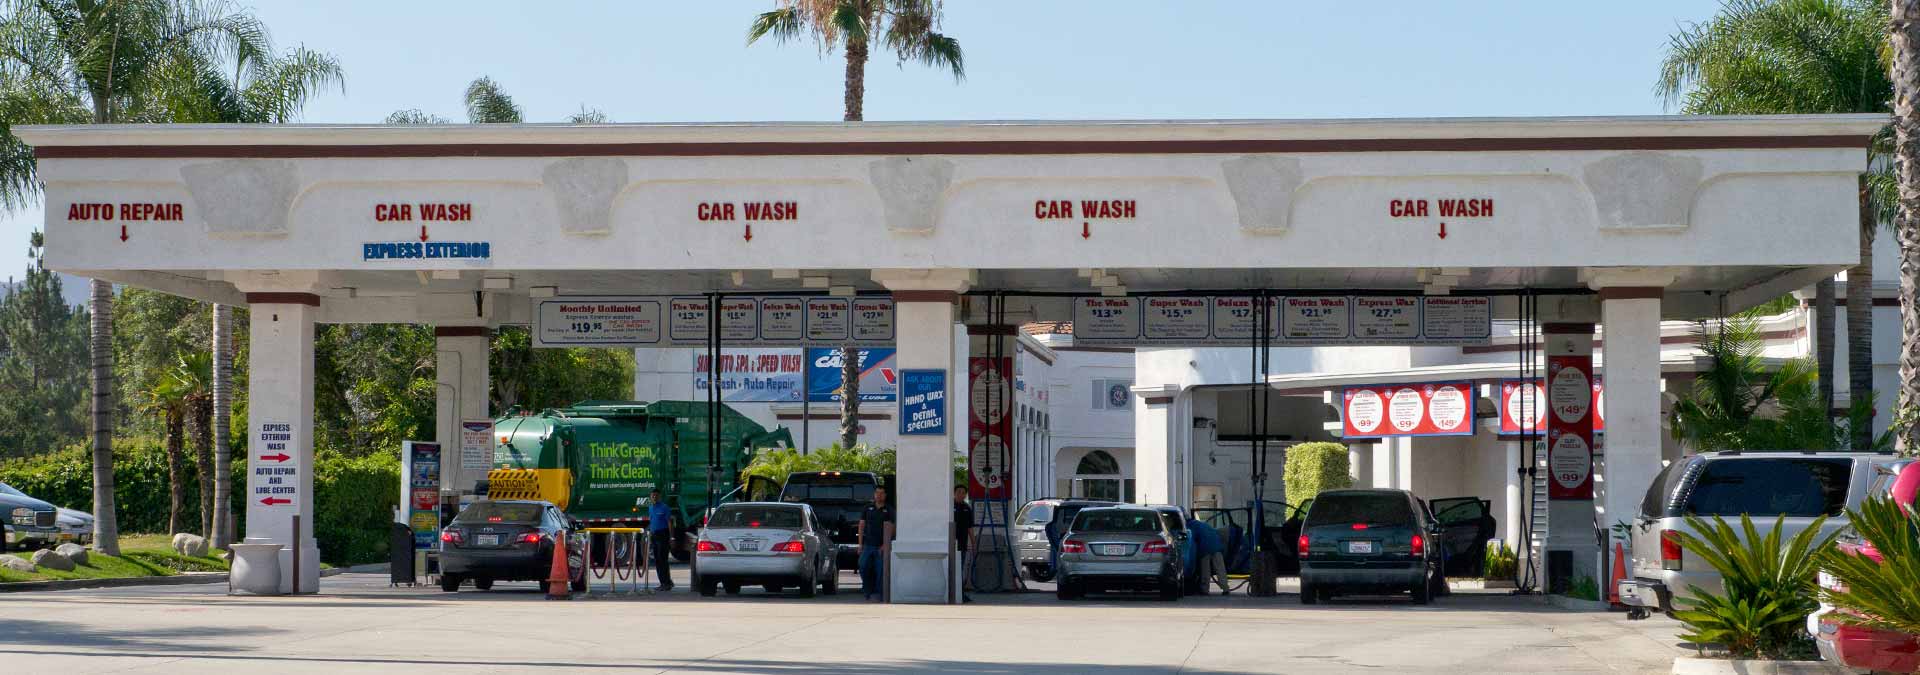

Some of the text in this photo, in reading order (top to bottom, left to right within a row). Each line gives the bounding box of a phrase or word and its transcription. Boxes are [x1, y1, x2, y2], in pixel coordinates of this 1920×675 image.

[68, 203, 184, 221] AUTO REPAIR
[375, 203, 472, 222] CAR WASH
[697, 201, 798, 221] CAR WASH
[1035, 199, 1136, 219] CAR WASH
[1390, 199, 1493, 217] CAR WASH
[363, 242, 490, 260] EXPRESS EXTERIOR
[560, 304, 641, 313] Monthly Unlimited
[1087, 299, 1129, 307] The Wash
[1150, 298, 1204, 308] Super Wash
[1217, 299, 1248, 307] Deluxe
[1289, 298, 1344, 307] Works Wash
[1358, 298, 1415, 308] Express Wax
[572, 322, 602, 333] $19.95
[716, 353, 734, 373] UTO
[736, 353, 749, 373] SPA
[757, 353, 779, 373] SPEED
[780, 353, 802, 373] WASH
[715, 377, 737, 390] ash
[743, 377, 764, 390] Auto
[766, 377, 795, 393] Repair
[905, 390, 944, 406] HAND WAX
[912, 409, 937, 422] DETAIL
[907, 417, 942, 432] SPECIALS!
[261, 433, 291, 441] EXTERIOR
[590, 442, 656, 461] Think Green,
[256, 467, 296, 476] AUTO REPAIR
[590, 463, 653, 479] Think Clean.
[272, 486, 295, 494] CENTER
